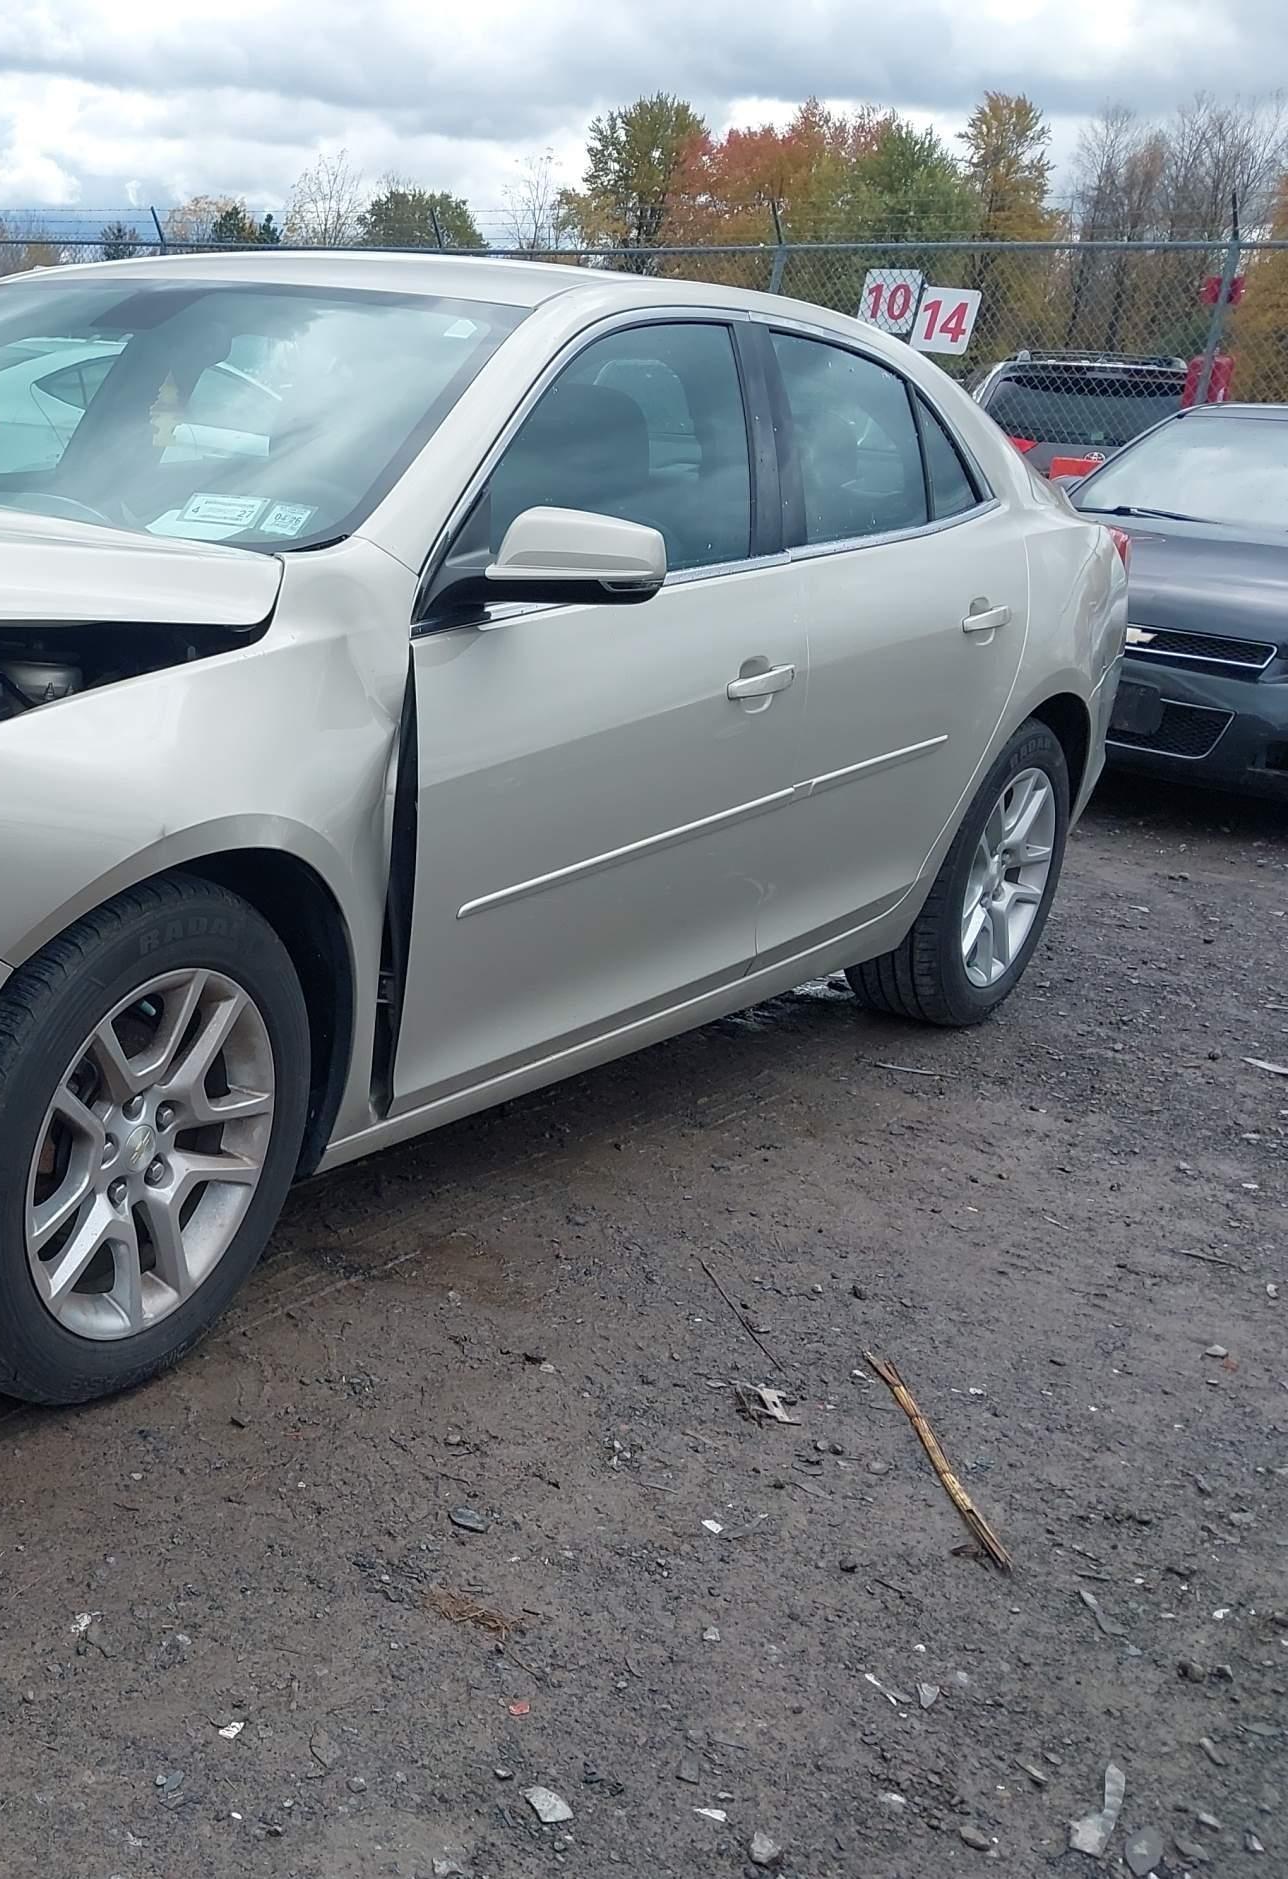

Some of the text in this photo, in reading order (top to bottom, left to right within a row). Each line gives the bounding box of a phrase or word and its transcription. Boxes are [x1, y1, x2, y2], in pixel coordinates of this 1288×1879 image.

[868, 283, 912, 321] 10
[923, 300, 969, 344] 14
[237, 510, 255, 519] 27
